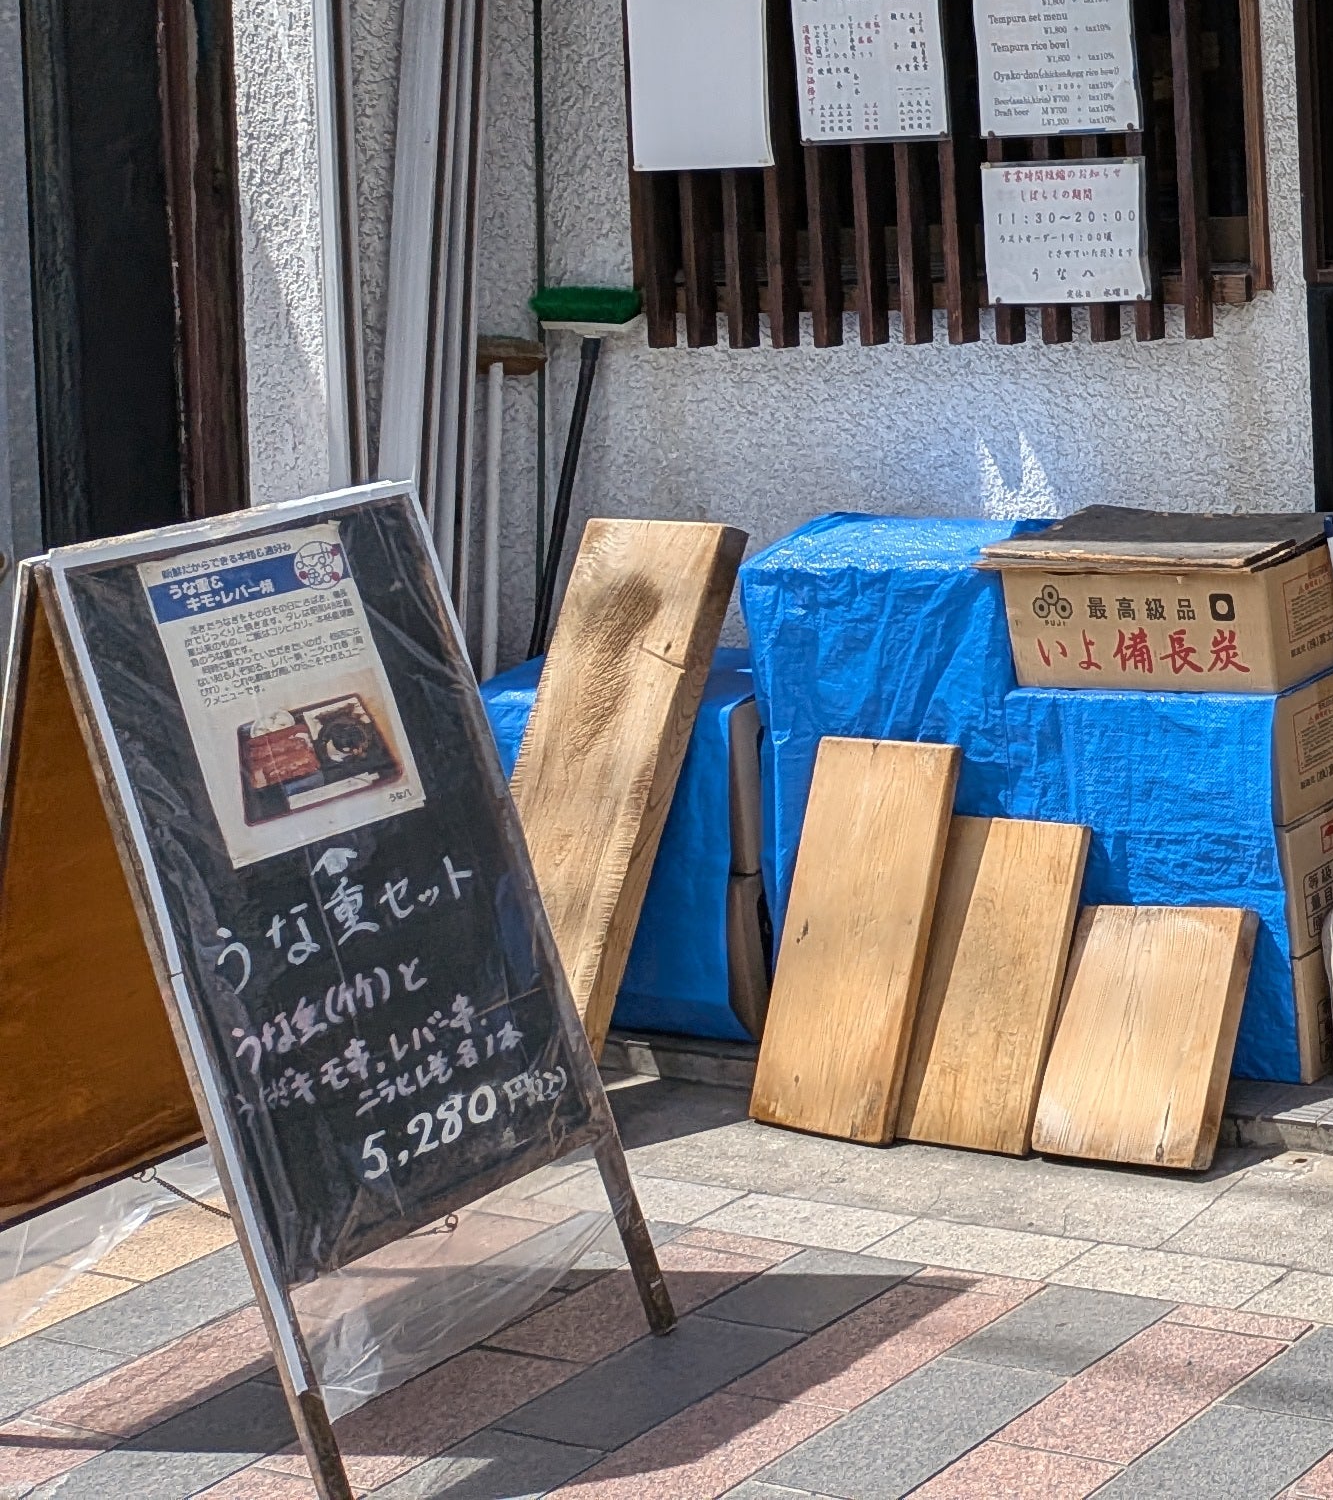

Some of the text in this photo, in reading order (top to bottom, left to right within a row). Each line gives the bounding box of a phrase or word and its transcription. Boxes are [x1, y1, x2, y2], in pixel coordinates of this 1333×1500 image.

[988, 13, 1068, 25] Tempura set menu
[991, 39, 1070, 54] Tempura rice bowl
[1021, 188, 1093, 202] しばらくの期間
[1087, 597, 1196, 620] 最高級品
[1037, 627, 1251, 674] いよ備長炭
[216, 855, 473, 995] うな重セット
